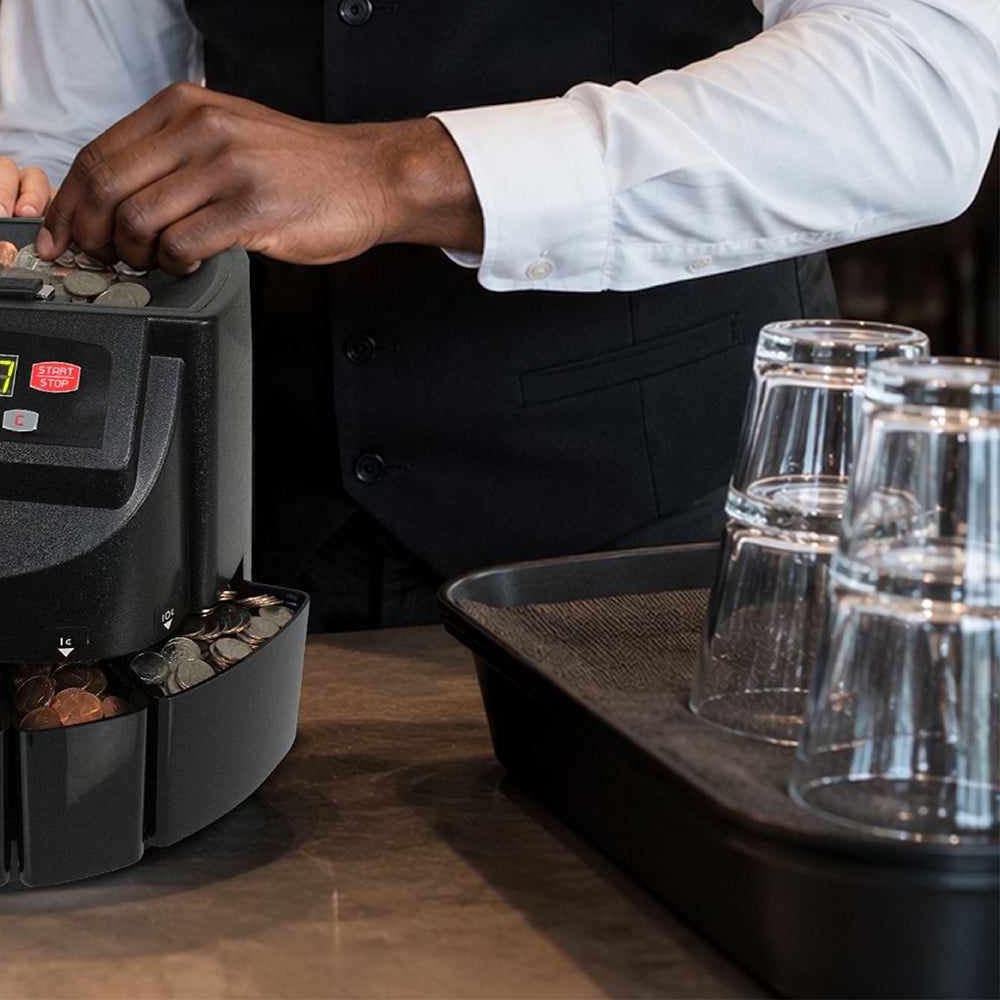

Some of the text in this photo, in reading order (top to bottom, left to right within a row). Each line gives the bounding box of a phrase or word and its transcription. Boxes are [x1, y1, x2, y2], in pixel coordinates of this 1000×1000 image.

[38, 365, 75, 376] START
[40, 377, 69, 387] STOP
[14, 414, 25, 427] C
